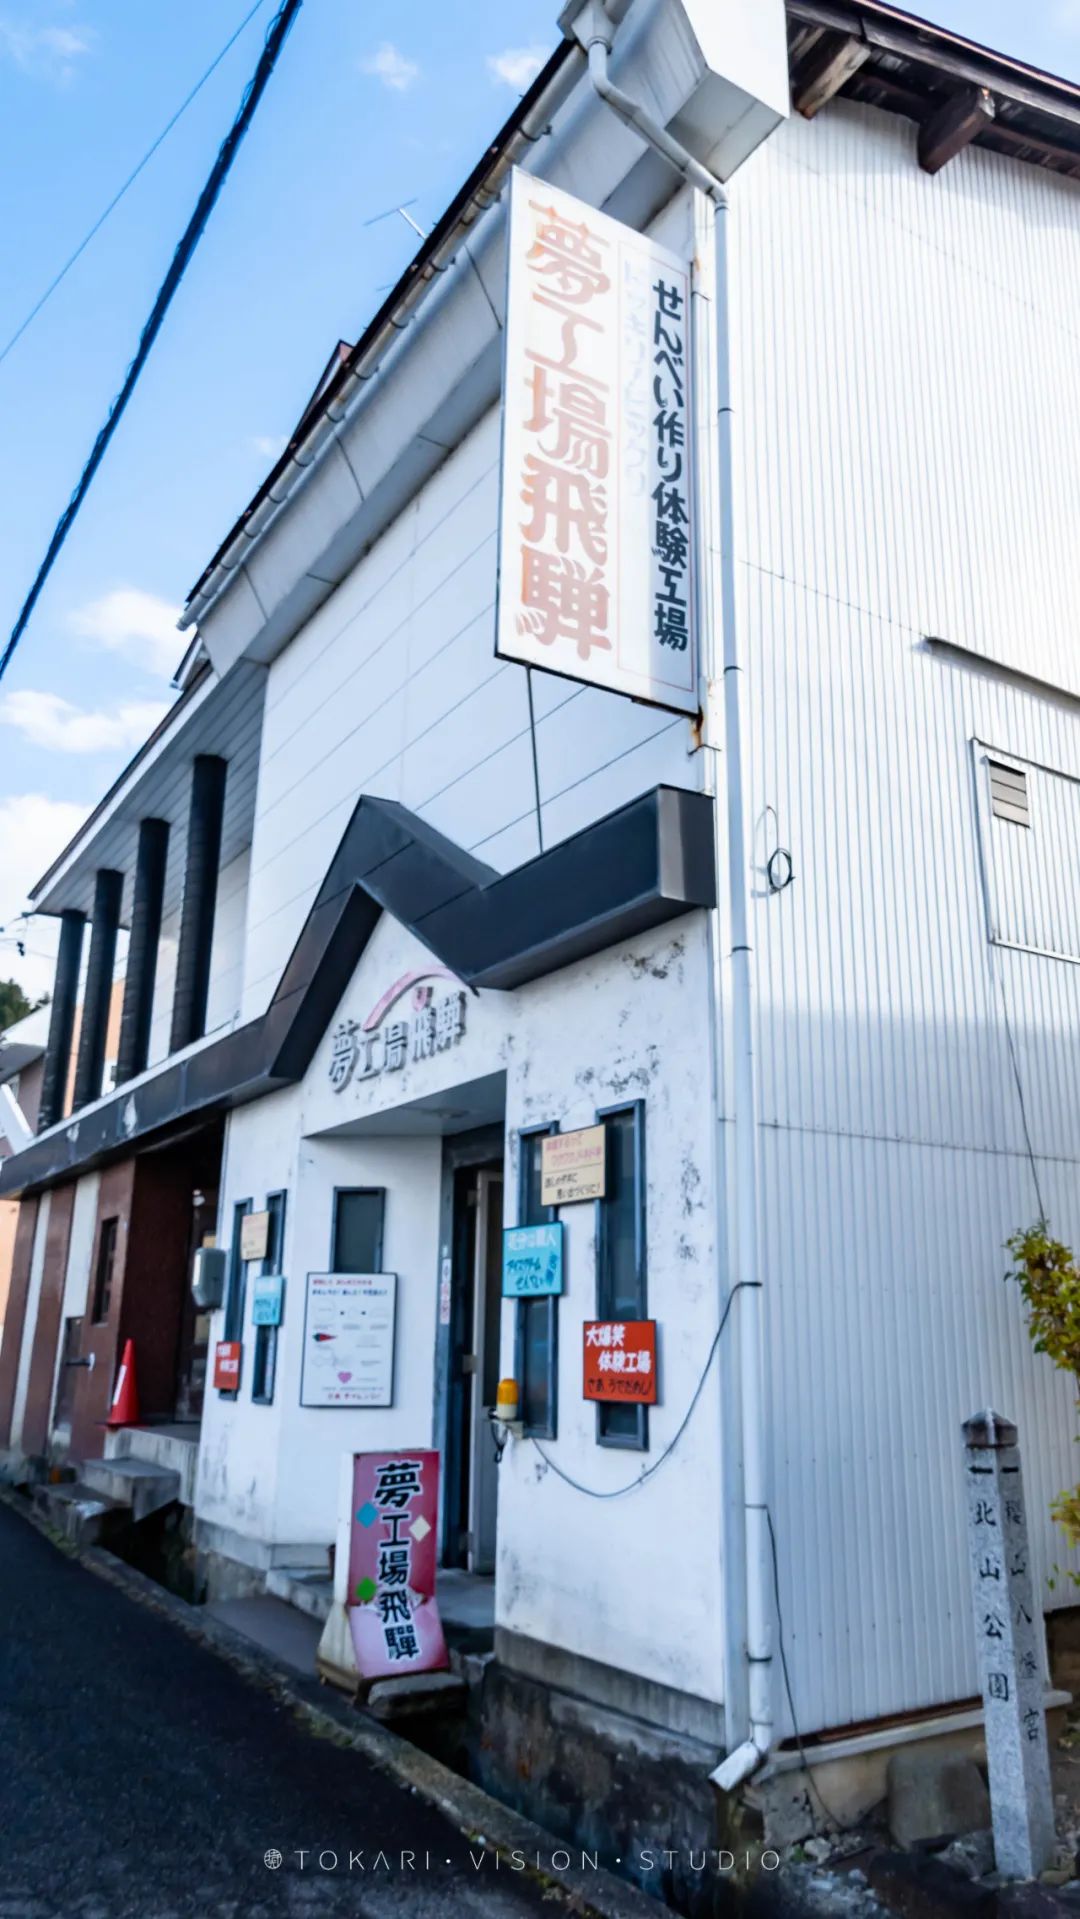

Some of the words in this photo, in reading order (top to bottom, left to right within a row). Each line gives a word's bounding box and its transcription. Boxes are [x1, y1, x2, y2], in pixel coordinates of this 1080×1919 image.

[651, 278, 691, 652] せんべい作り体験工場
[974, 1502, 1009, 1702] 北山公園
